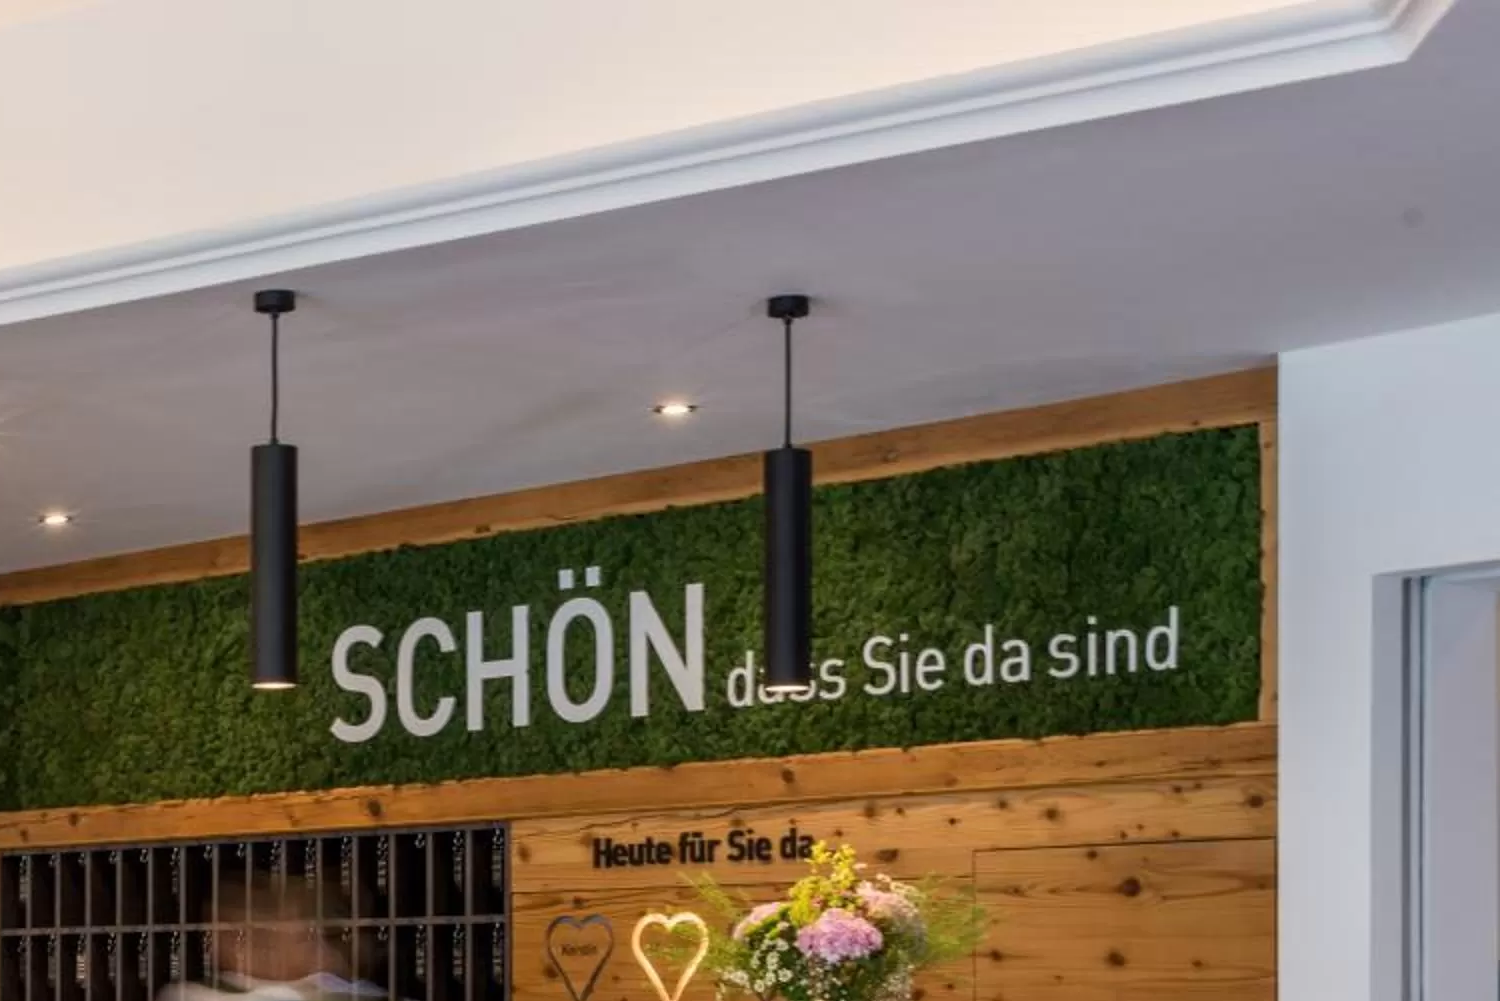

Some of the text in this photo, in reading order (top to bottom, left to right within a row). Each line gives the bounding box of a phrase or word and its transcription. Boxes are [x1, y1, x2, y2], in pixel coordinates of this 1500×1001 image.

[329, 565, 705, 744] SCHÖN
[863, 632, 946, 696] Sie
[963, 623, 1031, 686] da
[1048, 605, 1179, 679] sind
[592, 827, 815, 869] Heute für Sie da
